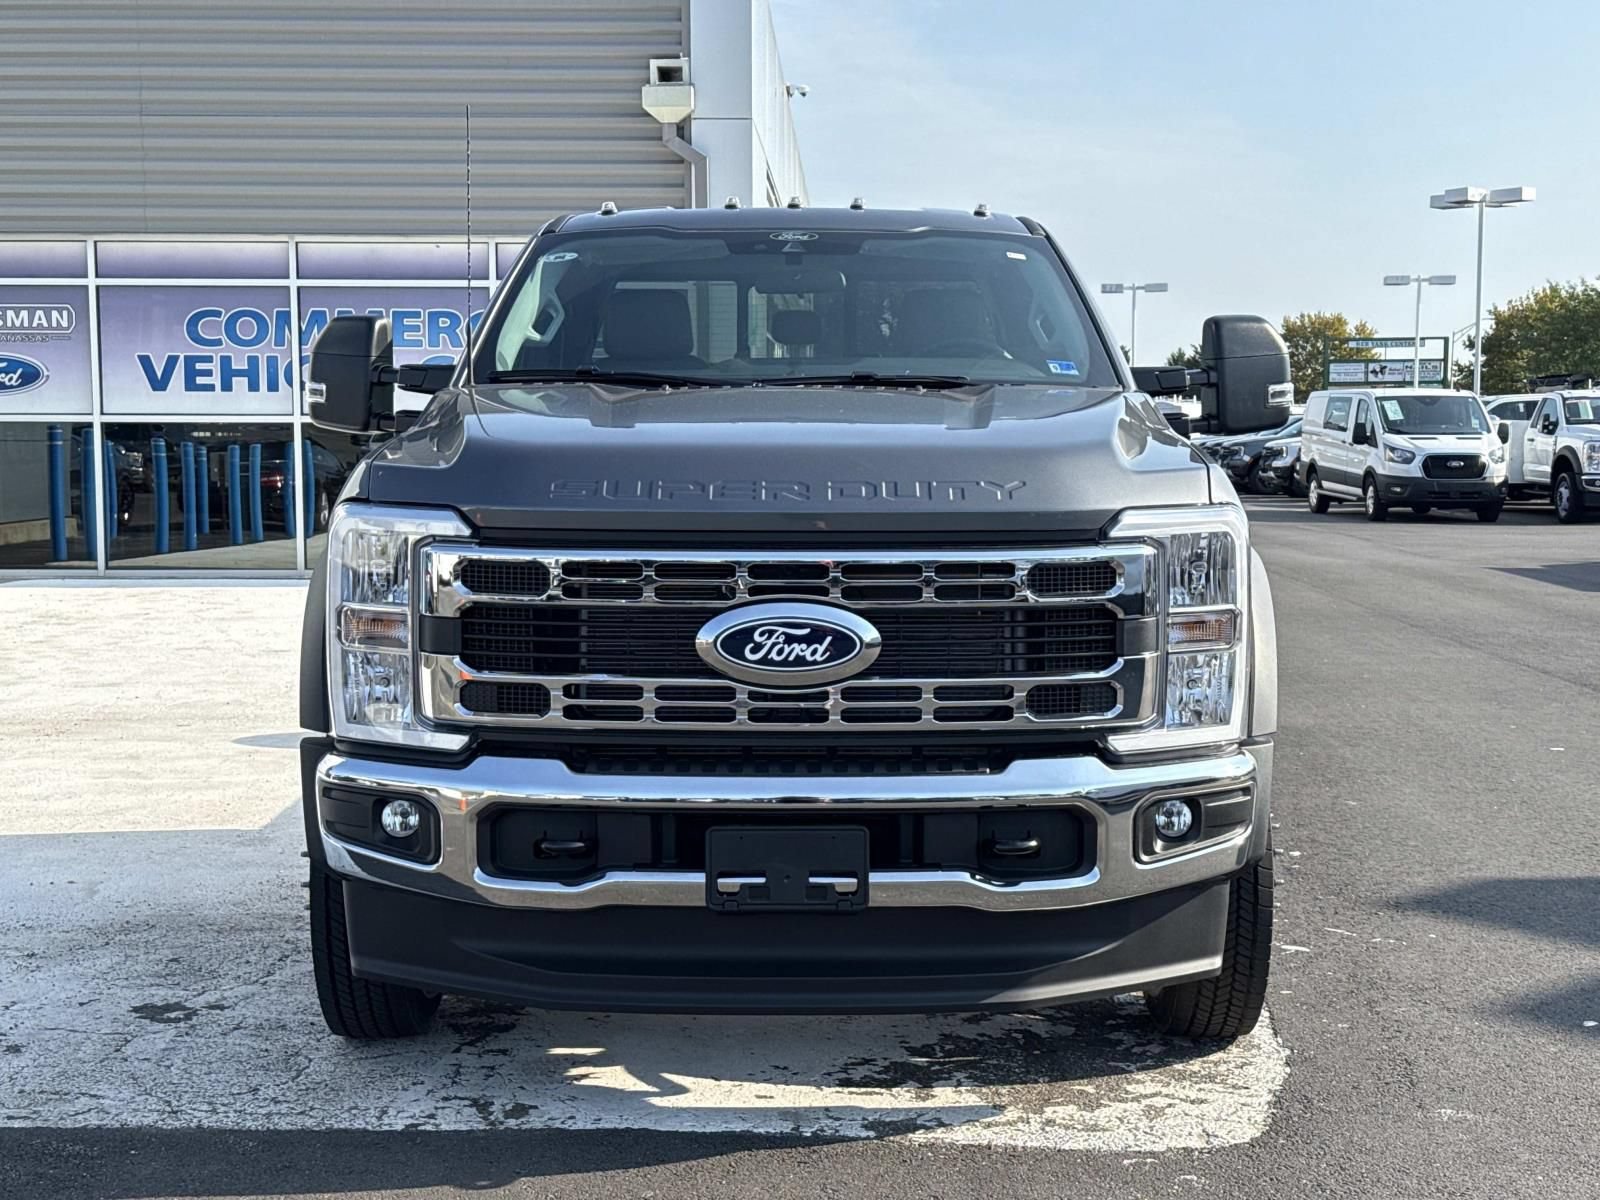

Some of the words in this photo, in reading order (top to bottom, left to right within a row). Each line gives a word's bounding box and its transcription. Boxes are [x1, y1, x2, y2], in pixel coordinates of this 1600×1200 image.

[185, 307, 486, 349] COMER
[549, 479, 812, 501] SUPER
[826, 480, 1027, 502] DUTY
[744, 625, 832, 662] Ford
